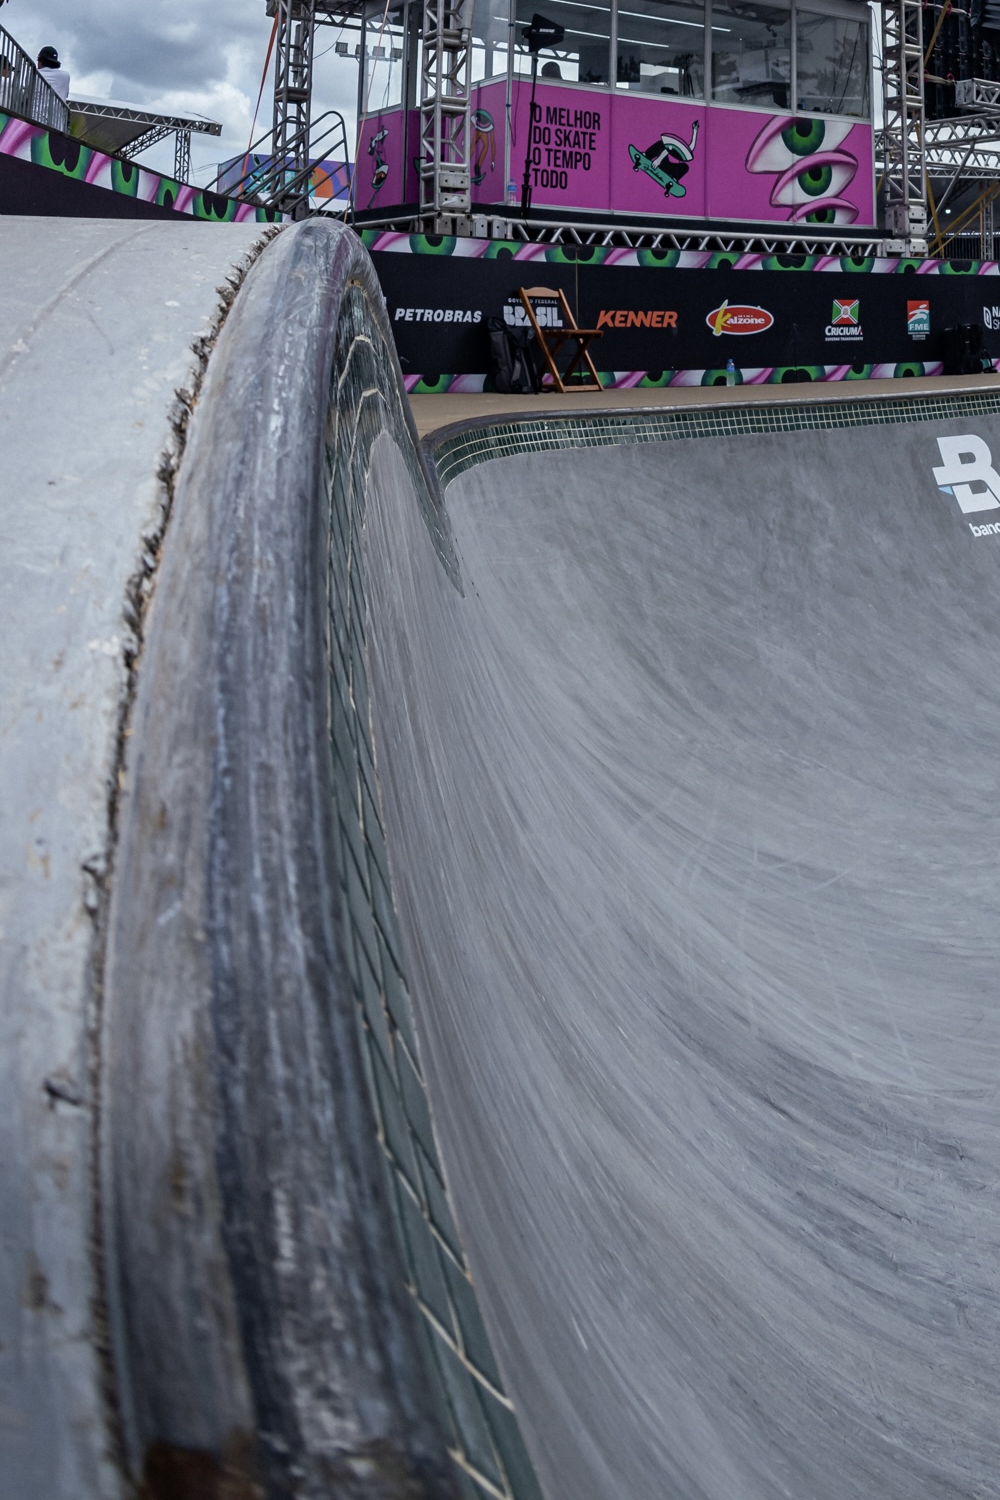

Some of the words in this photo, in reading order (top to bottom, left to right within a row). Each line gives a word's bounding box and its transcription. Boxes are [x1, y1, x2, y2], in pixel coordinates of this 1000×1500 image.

[545, 106, 601, 131] MELHOR
[533, 125, 551, 146] DO
[554, 128, 597, 151] SKATE
[532, 147, 542, 166] O
[545, 148, 591, 171] TEMPO
[532, 168, 568, 190] TODO
[394, 307, 482, 323] PETROBRAS
[595, 310, 678, 330] KENNER
[909, 323, 929, 331] FME
